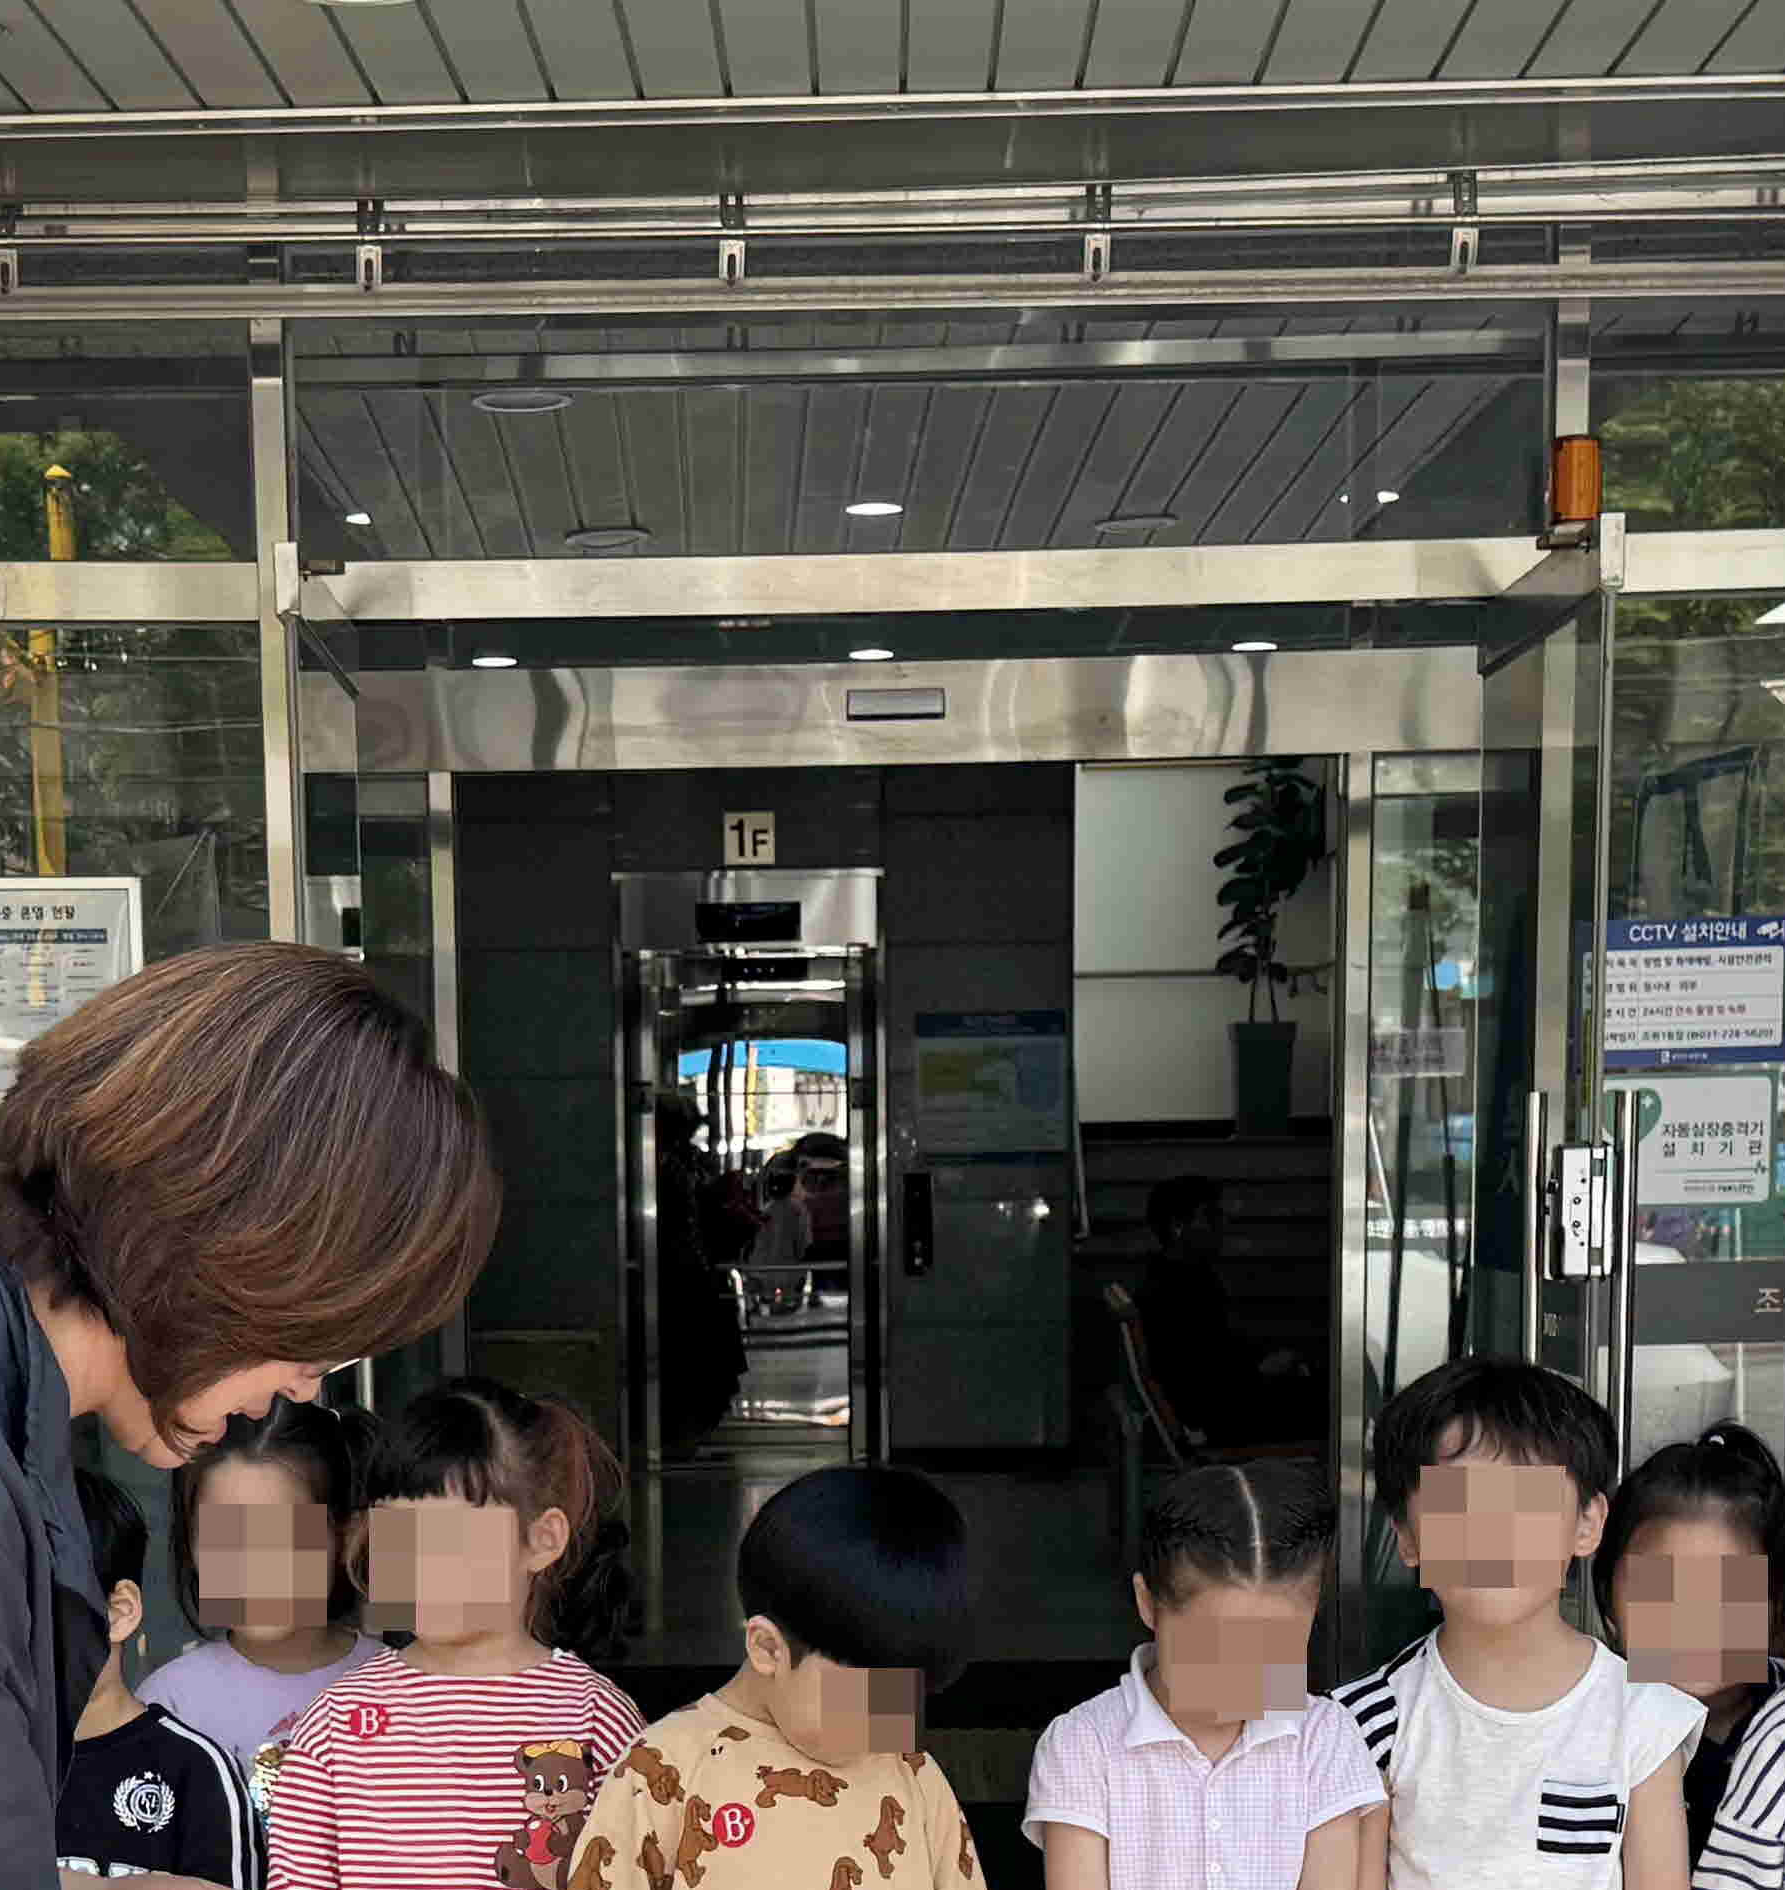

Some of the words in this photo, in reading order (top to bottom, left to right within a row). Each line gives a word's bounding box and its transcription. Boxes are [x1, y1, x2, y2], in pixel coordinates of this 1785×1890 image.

[729, 818, 768, 856] 1F
[1629, 924, 1677, 942] CCTV
[1681, 919, 1748, 943] 설치안내
[1663, 1120, 1763, 1138] 자동심장충격기
